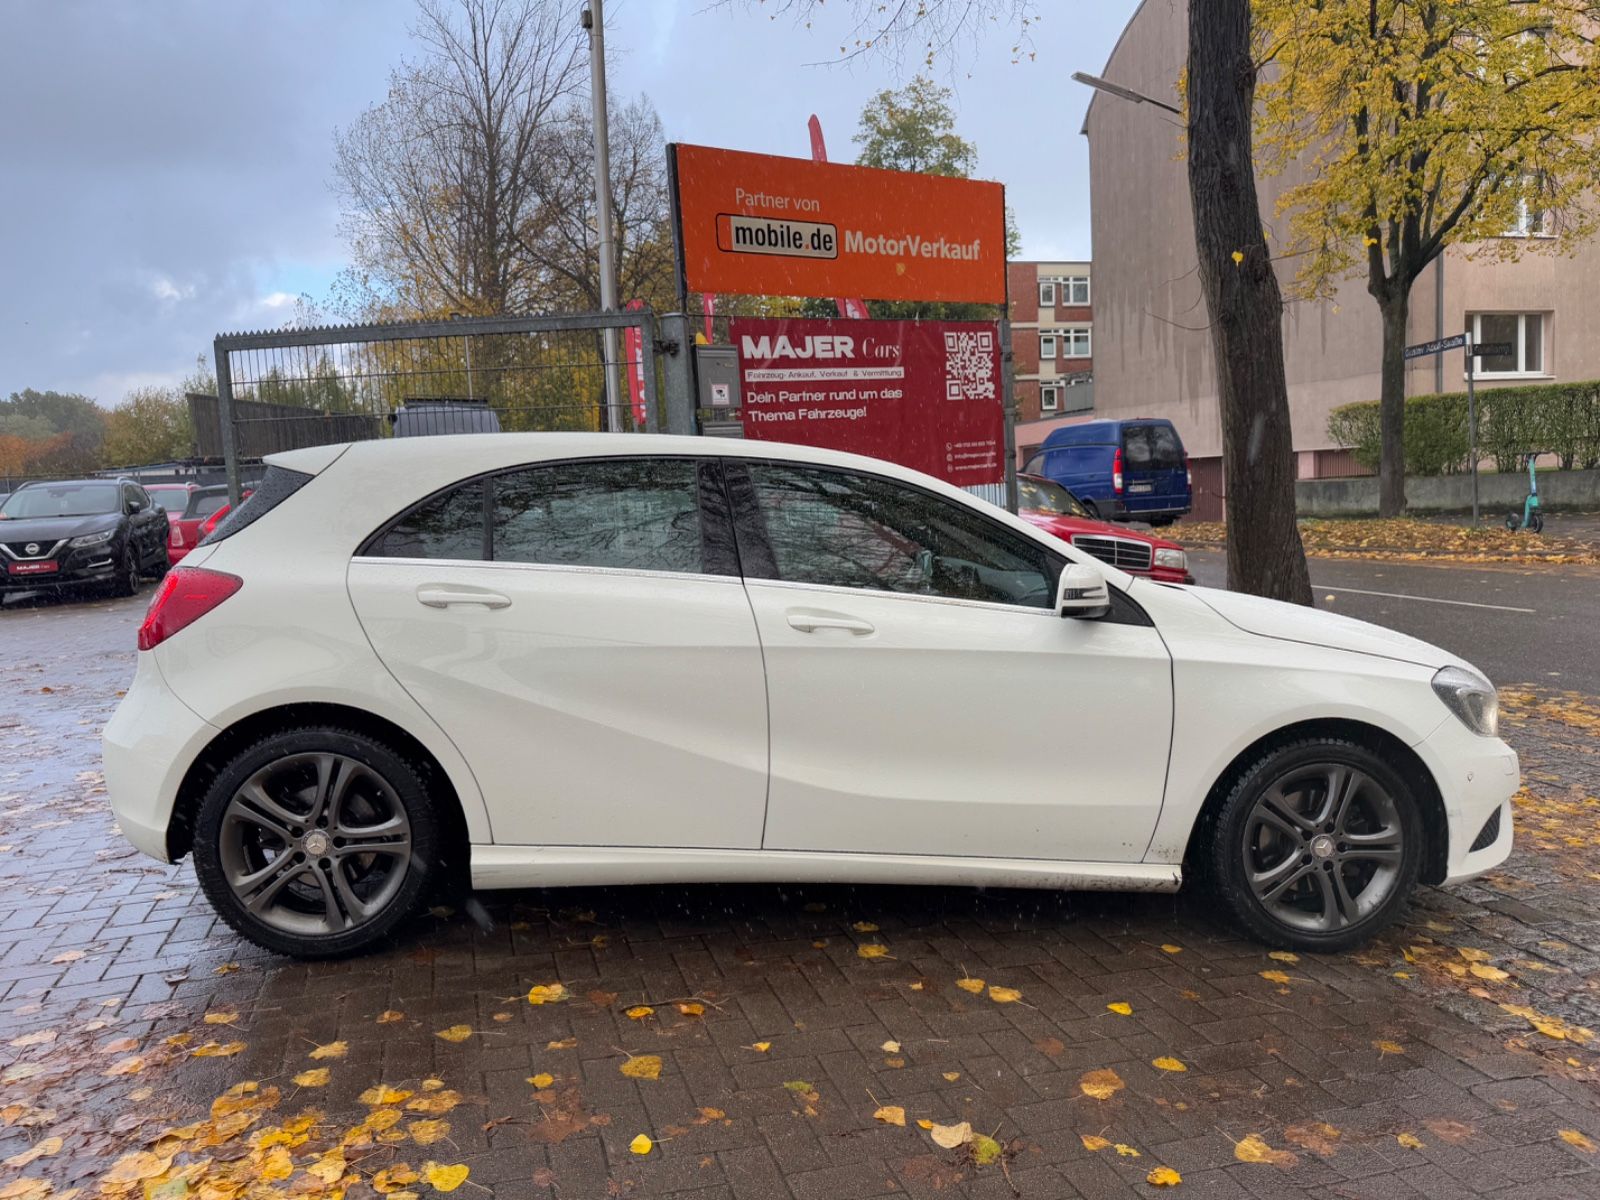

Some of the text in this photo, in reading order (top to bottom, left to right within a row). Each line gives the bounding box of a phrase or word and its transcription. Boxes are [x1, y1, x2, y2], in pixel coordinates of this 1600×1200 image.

[735, 187, 820, 212] Partner von
[735, 223, 981, 260] mobile.de MotorVerkauf
[741, 335, 900, 359] MAJER Cars
[861, 369, 902, 377] Vermittlung
[747, 387, 903, 403] Dein Partner rund um das
[748, 405, 867, 422] Thema Fahrzeuge!
